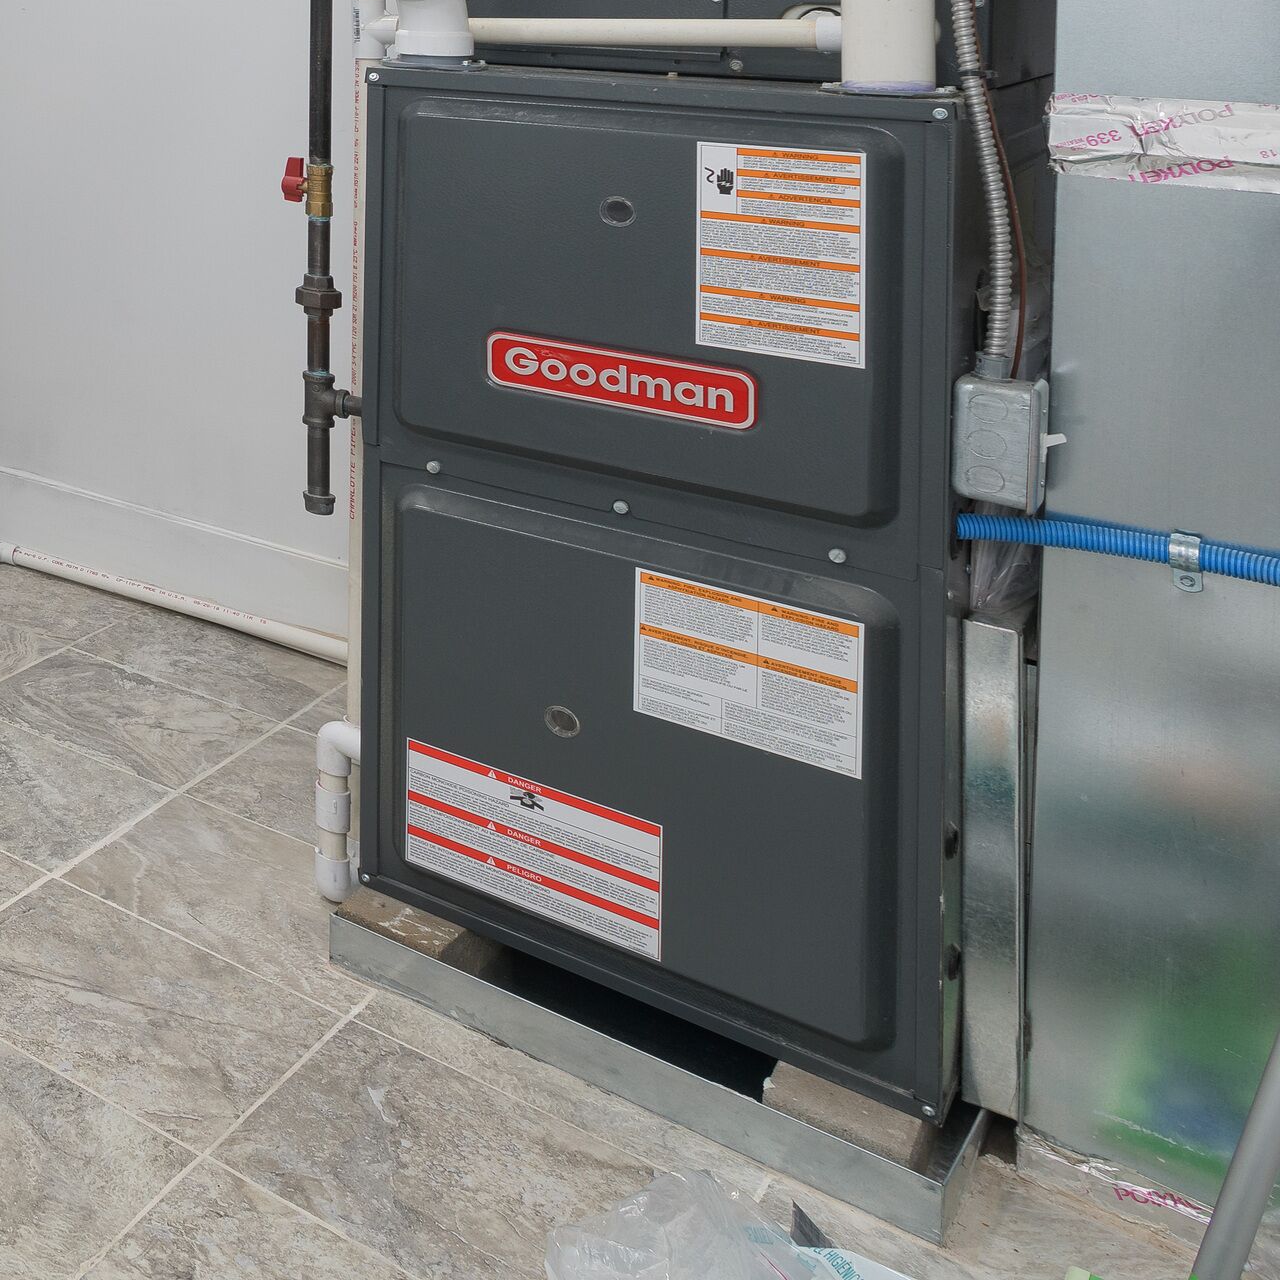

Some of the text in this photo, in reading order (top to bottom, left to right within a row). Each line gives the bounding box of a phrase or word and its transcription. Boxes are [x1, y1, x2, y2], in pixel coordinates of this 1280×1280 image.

[1086, 129, 1122, 147] 339
[782, 152, 819, 161] WARNING
[772, 172, 838, 183] AVERTISSEMENT
[778, 194, 833, 204] ADVERTENCIA
[769, 218, 806, 228] WARNING
[758, 255, 821, 268] AVERTISSEMENT
[770, 294, 806, 304] WARNING
[758, 322, 820, 334] AVERTISSEMENT
[504, 347, 734, 412] Goodman
[508, 776, 542, 794] DANGER
[507, 828, 541, 846] DANGER
[506, 864, 542, 882] PELIGRO
